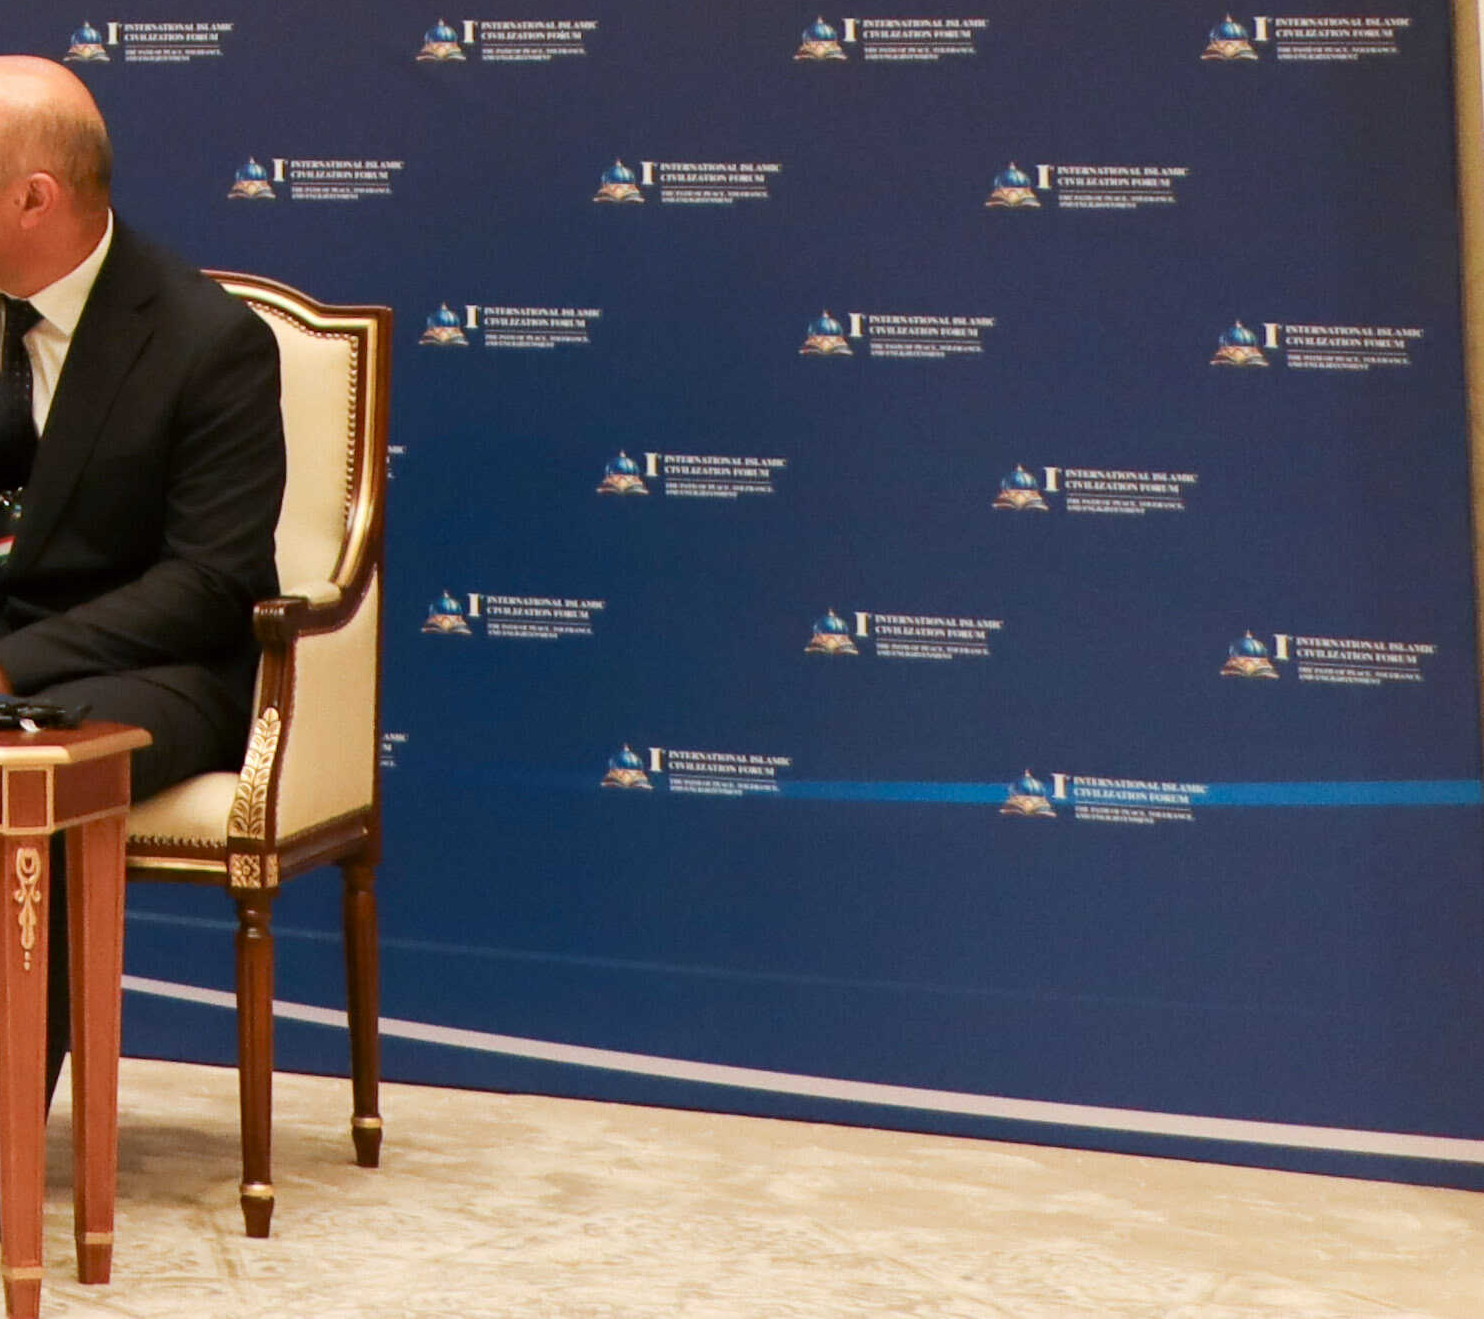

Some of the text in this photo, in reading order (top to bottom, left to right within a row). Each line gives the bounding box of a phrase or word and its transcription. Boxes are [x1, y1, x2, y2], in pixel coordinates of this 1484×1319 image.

[1275, 18, 1411, 27] INTERNATIONAL ISLAMIC
[1275, 29, 1350, 38] CIVILIZATION
[1057, 166, 1187, 176] INTERNATIONAL ISLAMIC
[1057, 177, 1129, 187] CIVILIZATION
[1285, 325, 1423, 337] INTERNATIONAL ISLAMIC
[1285, 336, 1405, 348] CIVILIZATION FORUM
[1064, 469, 1196, 483] INTERNATIONAL ISLAMIC
[1064, 480, 1179, 493] CIVILIZATION FORUM
[1296, 637, 1435, 654] INTERNATIONAL ISLAMIC
[1296, 648, 1417, 664] CIVILIZATION FORUM
